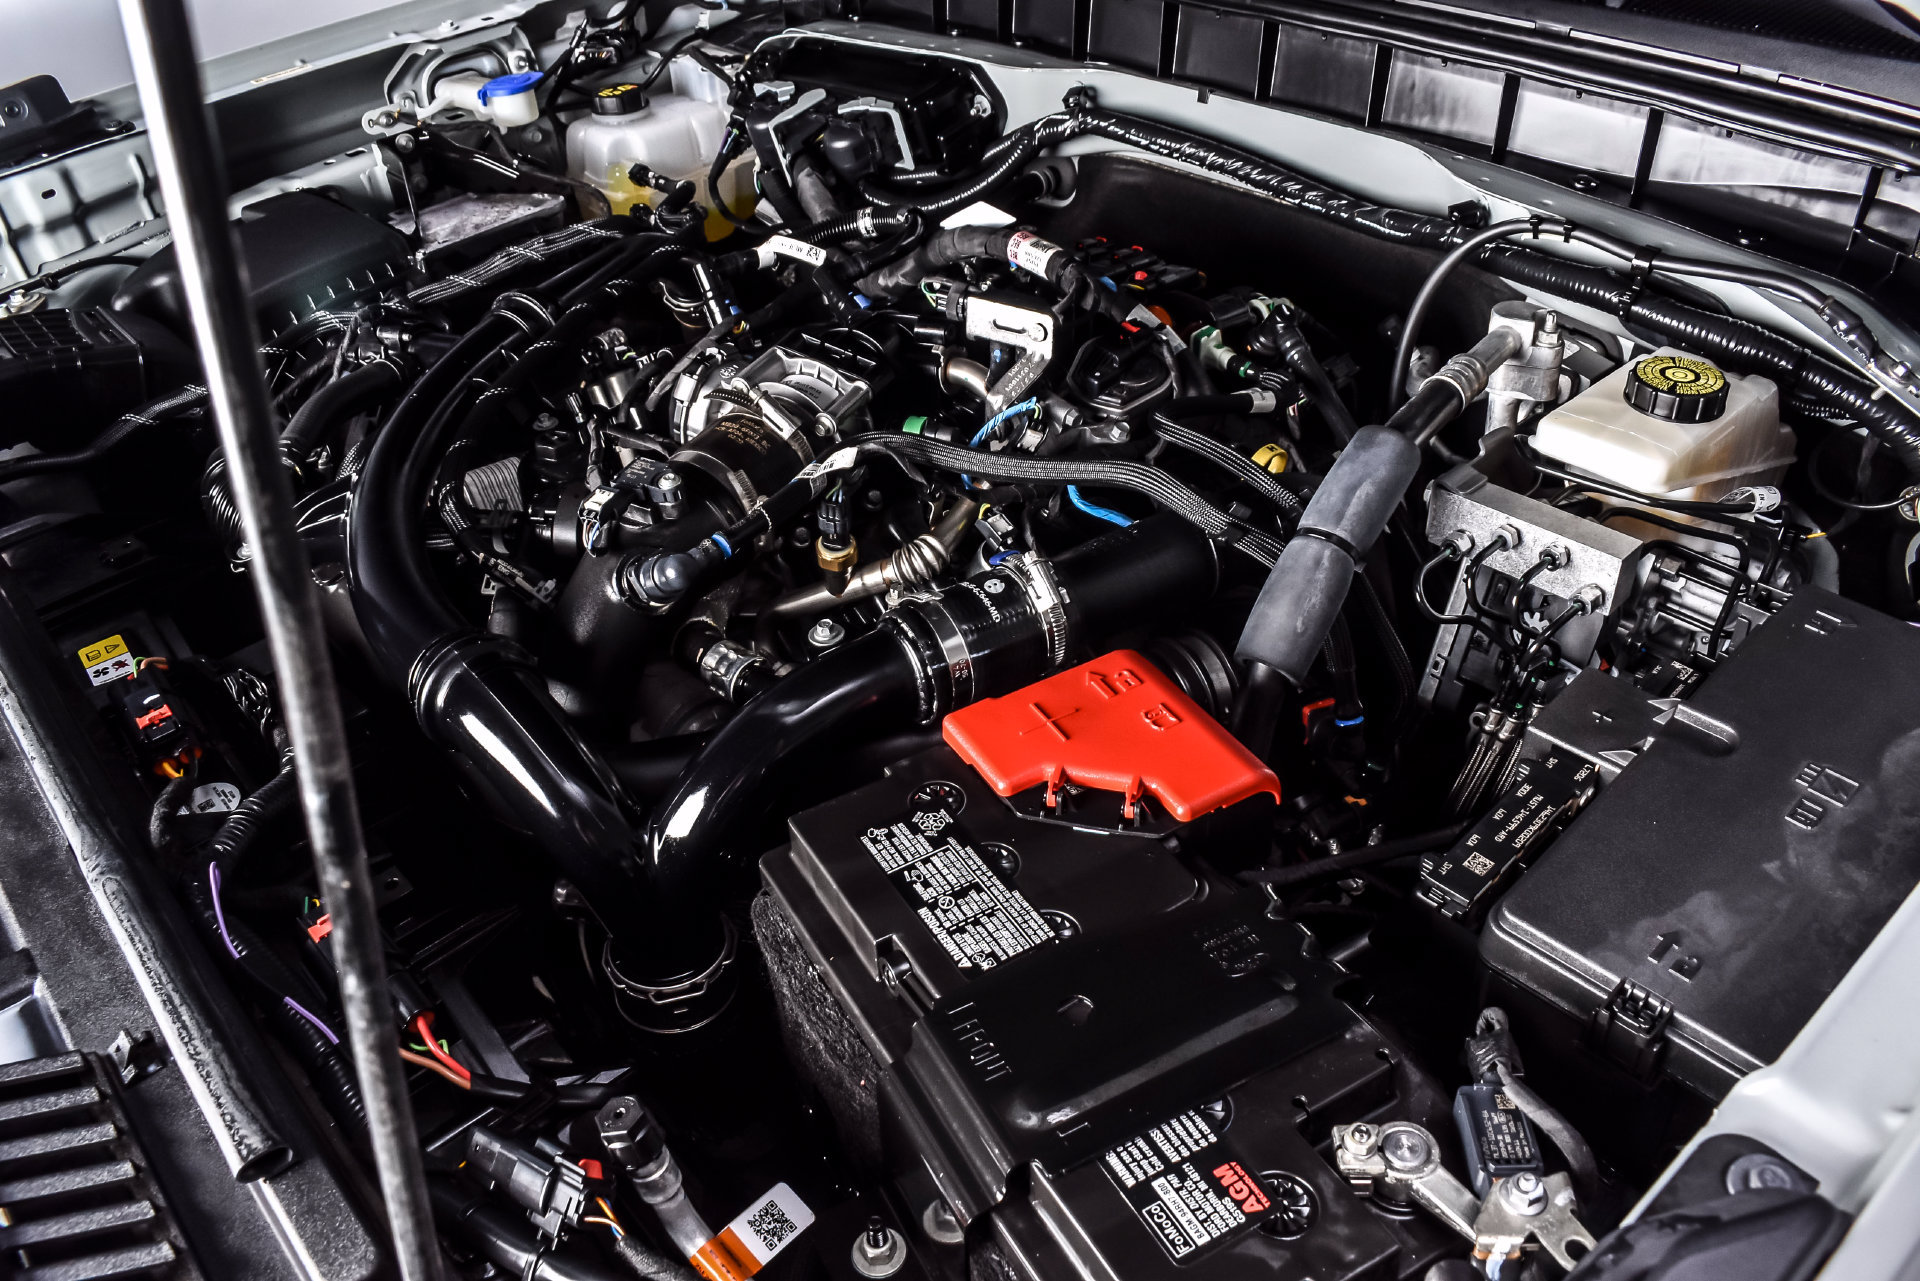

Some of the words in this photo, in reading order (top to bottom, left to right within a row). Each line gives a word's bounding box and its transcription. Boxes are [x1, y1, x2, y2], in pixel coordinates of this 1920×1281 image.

[1516, 783, 1532, 797] 300A
[917, 907, 965, 961] DANGER/POISON
[1198, 1138, 1208, 1147] de
[1207, 1133, 1217, 1143] de
[1120, 1151, 1132, 1163] see
[1128, 1145, 1143, 1160] start
[1178, 1145, 1190, 1157] des
[1140, 1159, 1157, 1176] jump
[1148, 1156, 1164, 1171] Cold
[1182, 1162, 1200, 1181] 48121
[1167, 1174, 1182, 1188] PAR
[1184, 1177, 1196, 1191] CO.
[1196, 1180, 1208, 1191] MI
[1213, 1163, 1264, 1213] AGM
[1230, 1162, 1271, 1208] TECHNOLOGY
[1179, 1187, 1199, 1210] DISTR.
[1192, 1189, 1215, 1214] MOTOR
[1195, 1210, 1207, 1220] BY
[1205, 1189, 1239, 1228] DEARBORN,
[1151, 1205, 1190, 1254] FoMoCo
[1203, 1218, 1221, 1238] DIST.
[1210, 1213, 1229, 1233] FORD
